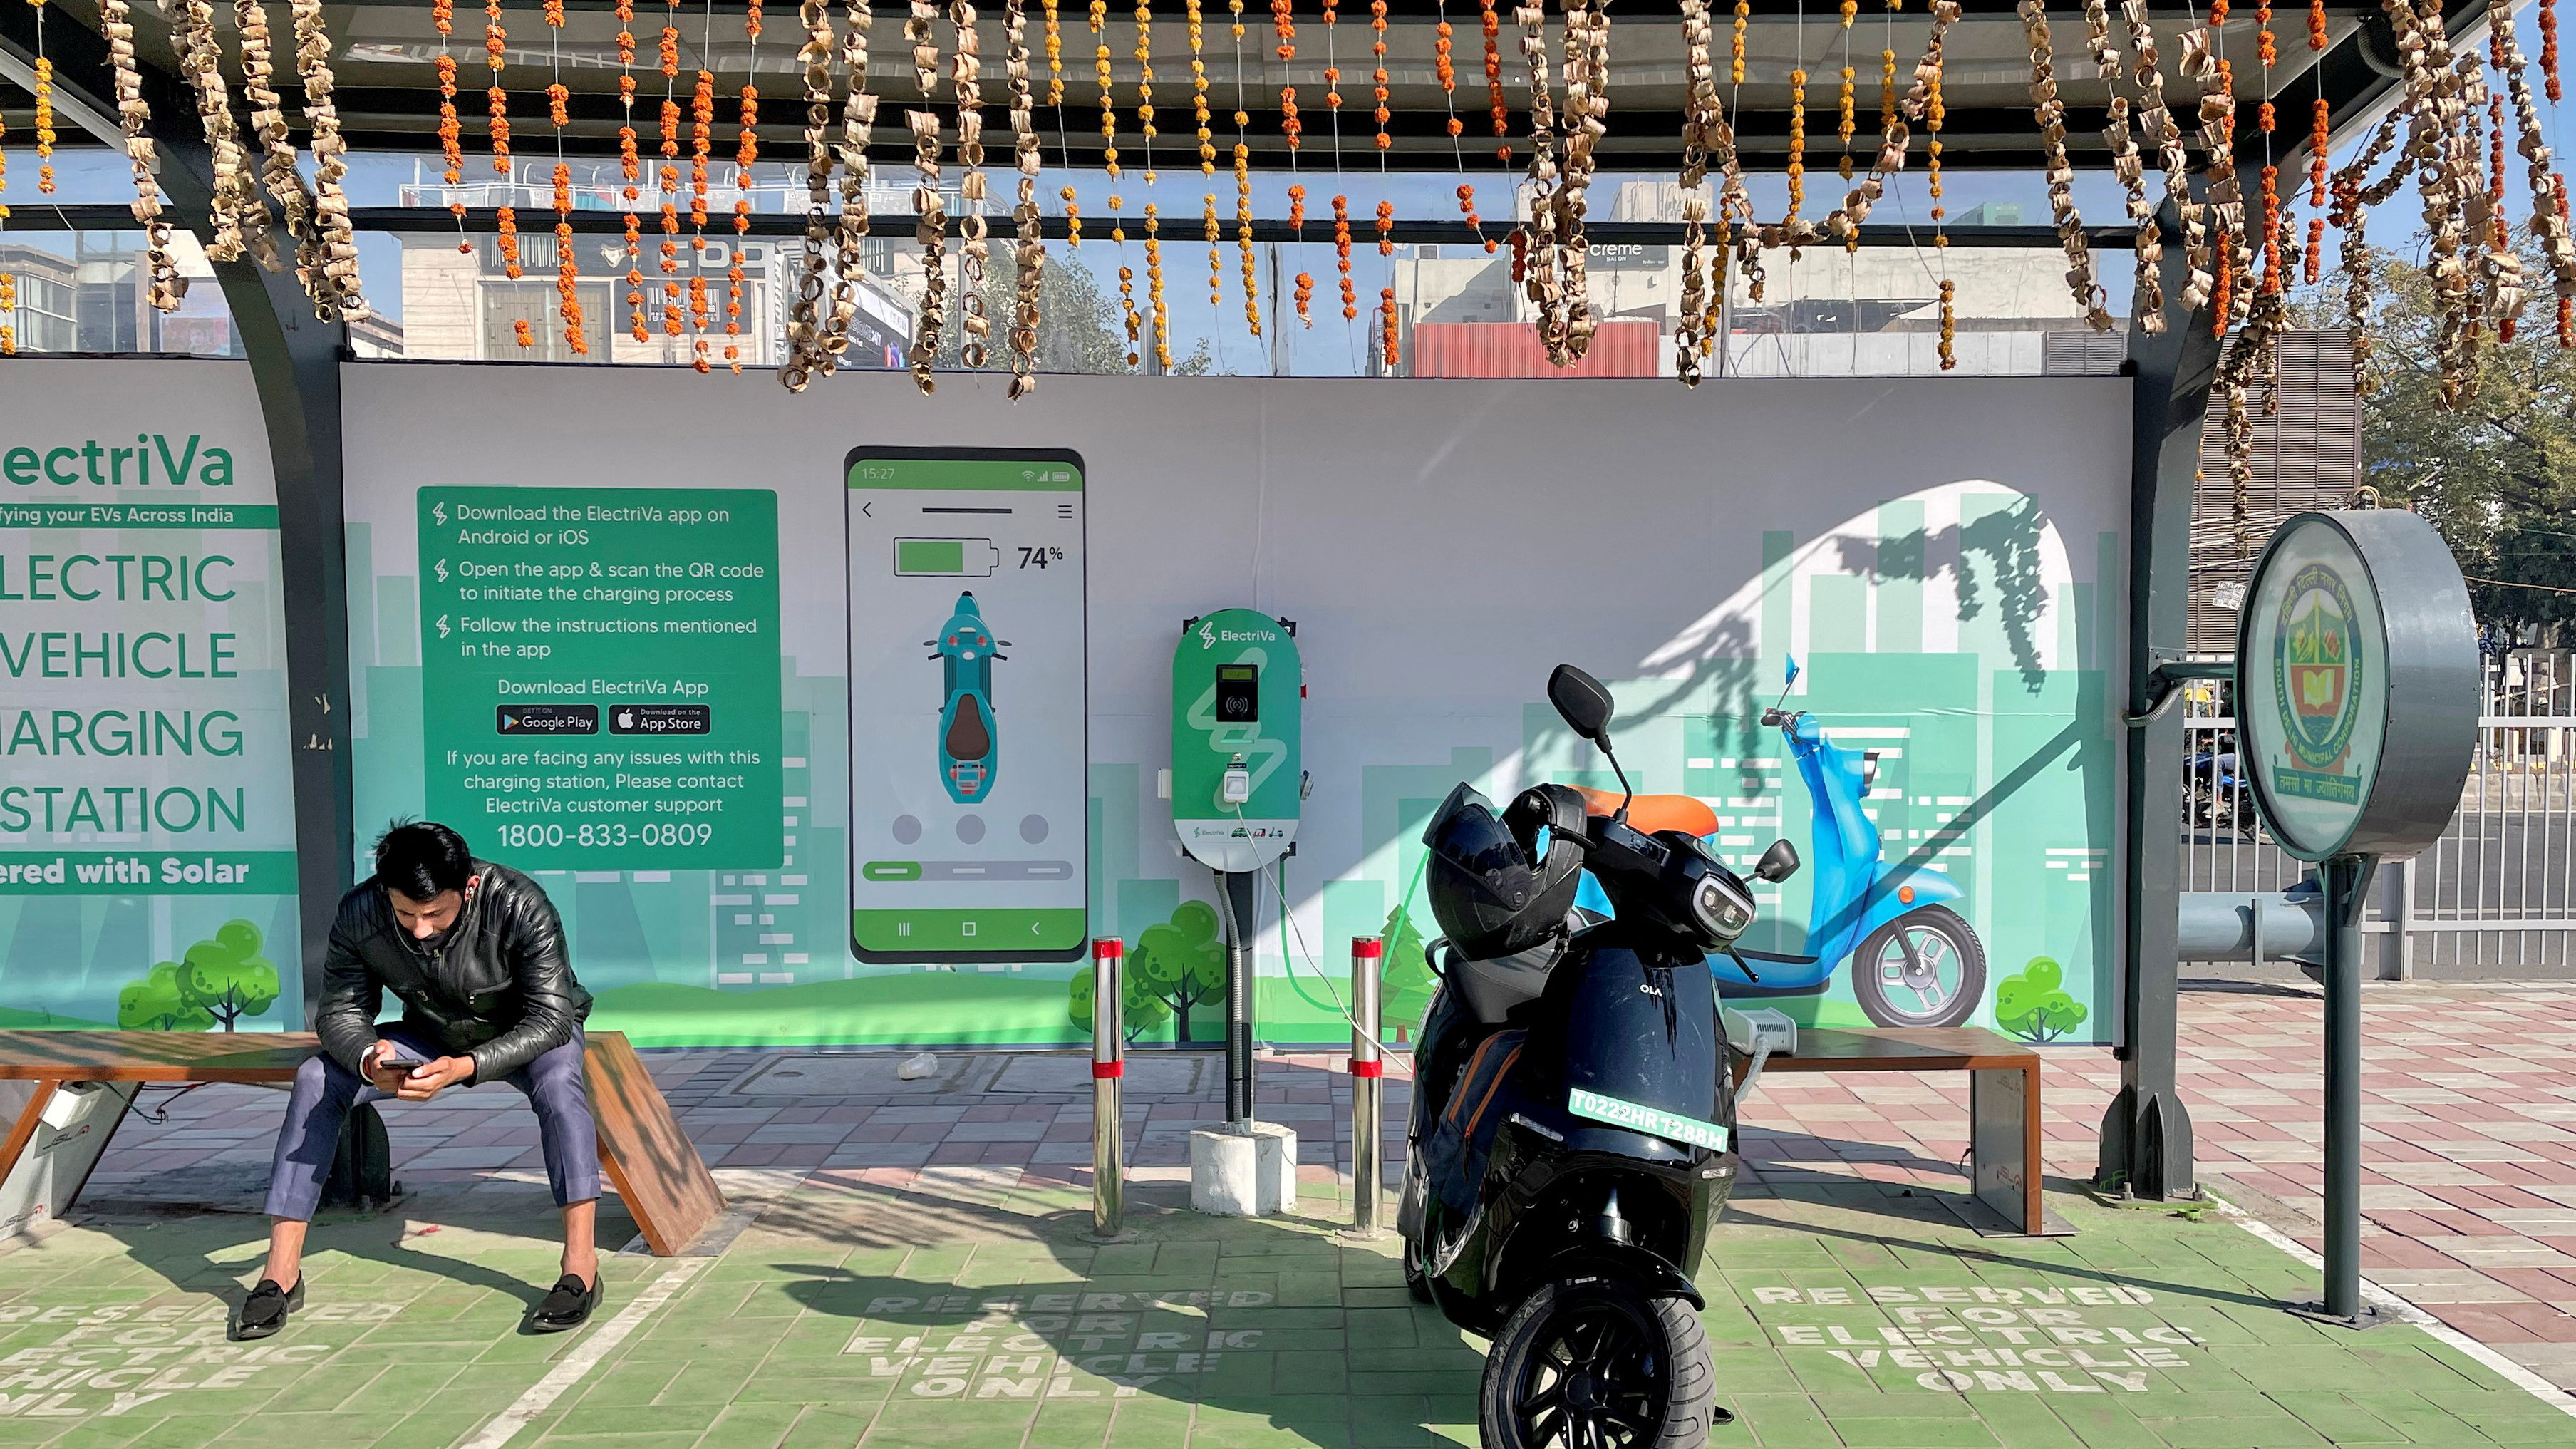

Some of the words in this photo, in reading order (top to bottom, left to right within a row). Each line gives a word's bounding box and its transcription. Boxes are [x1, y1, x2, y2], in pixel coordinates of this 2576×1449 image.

[3, 433, 233, 486] ectriVa
[862, 468, 895, 480] 15:27
[46, 510, 86, 525] your
[91, 507, 121, 522] EVs
[127, 507, 186, 522] Across
[192, 507, 234, 522] India
[458, 505, 546, 520] Download
[552, 506, 581, 520] the
[587, 506, 662, 521] ElectriVa
[668, 510, 702, 525] app
[708, 510, 729, 522] on
[458, 529, 529, 544] Android
[535, 533, 553, 544] or
[559, 530, 589, 545] iOS
[459, 561, 508, 579] Open
[514, 562, 543, 577] the
[549, 565, 583, 580] app
[589, 562, 603, 577] &
[609, 566, 648, 577] scan
[654, 562, 683, 577] the
[689, 562, 715, 577] QR
[720, 563, 764, 577] code
[460, 587, 477, 600] to
[484, 586, 542, 600] initiate
[548, 586, 577, 600] the
[583, 586, 659, 604] charging
[666, 590, 733, 604] process
[461, 617, 516, 632] Follow
[522, 618, 551, 632] the
[557, 618, 658, 633] instructions
[664, 619, 756, 633] mentioned
[1221, 630, 1276, 641] ElectriVa
[0, 632, 237, 679] VEHICLE
[462, 641, 476, 656] in
[482, 641, 511, 656] the
[517, 645, 551, 660] app
[499, 679, 586, 694] Download
[592, 679, 666, 694] ElectriVa
[673, 680, 708, 698] App
[2275, 658, 2285, 707] SOUTH
[2282, 713, 2298, 746] DELHI
[2298, 745, 2334, 764] MUNICIPAL
[2333, 658, 2361, 754] CORPORATION
[522, 716, 564, 730] Google
[568, 716, 593, 730] Play
[640, 718, 666, 732] App
[668, 717, 702, 729] Store
[0, 710, 243, 756] ARGING
[448, 750, 457, 765] If
[463, 754, 495, 768] you
[501, 754, 528, 765] are
[534, 750, 587, 768] facing
[594, 753, 624, 768] any
[631, 750, 682, 764] issues
[687, 750, 723, 764] with
[729, 750, 760, 764] this
[465, 774, 541, 793] charging
[547, 774, 609, 790] station,
[616, 773, 671, 788] Please
[677, 775, 743, 788] contact
[0, 787, 244, 832] STATION
[487, 798, 561, 813] ElectriVa
[567, 799, 648, 812] customer
[655, 799, 723, 815] support
[497, 824, 712, 847] 1800-833-0809
[75, 857, 150, 883] with
[161, 857, 249, 883] Solar
[1640, 984, 1662, 997] OLA
[865, 1291, 1273, 1314] RESERVED
[1752, 1287, 2153, 1305] RESERVED
[963, 1314, 1133, 1333] FOR
[1895, 1307, 2089, 1325] FOR
[844, 1331, 1263, 1353] ELECTRIC
[1778, 1326, 2207, 1346] ELECTRIC
[870, 1353, 1222, 1376] VEHICLE
[1826, 1347, 2190, 1367] VEHICLE
[911, 1376, 1166, 1398] ONLY
[1917, 1370, 2148, 1392] ONLY
